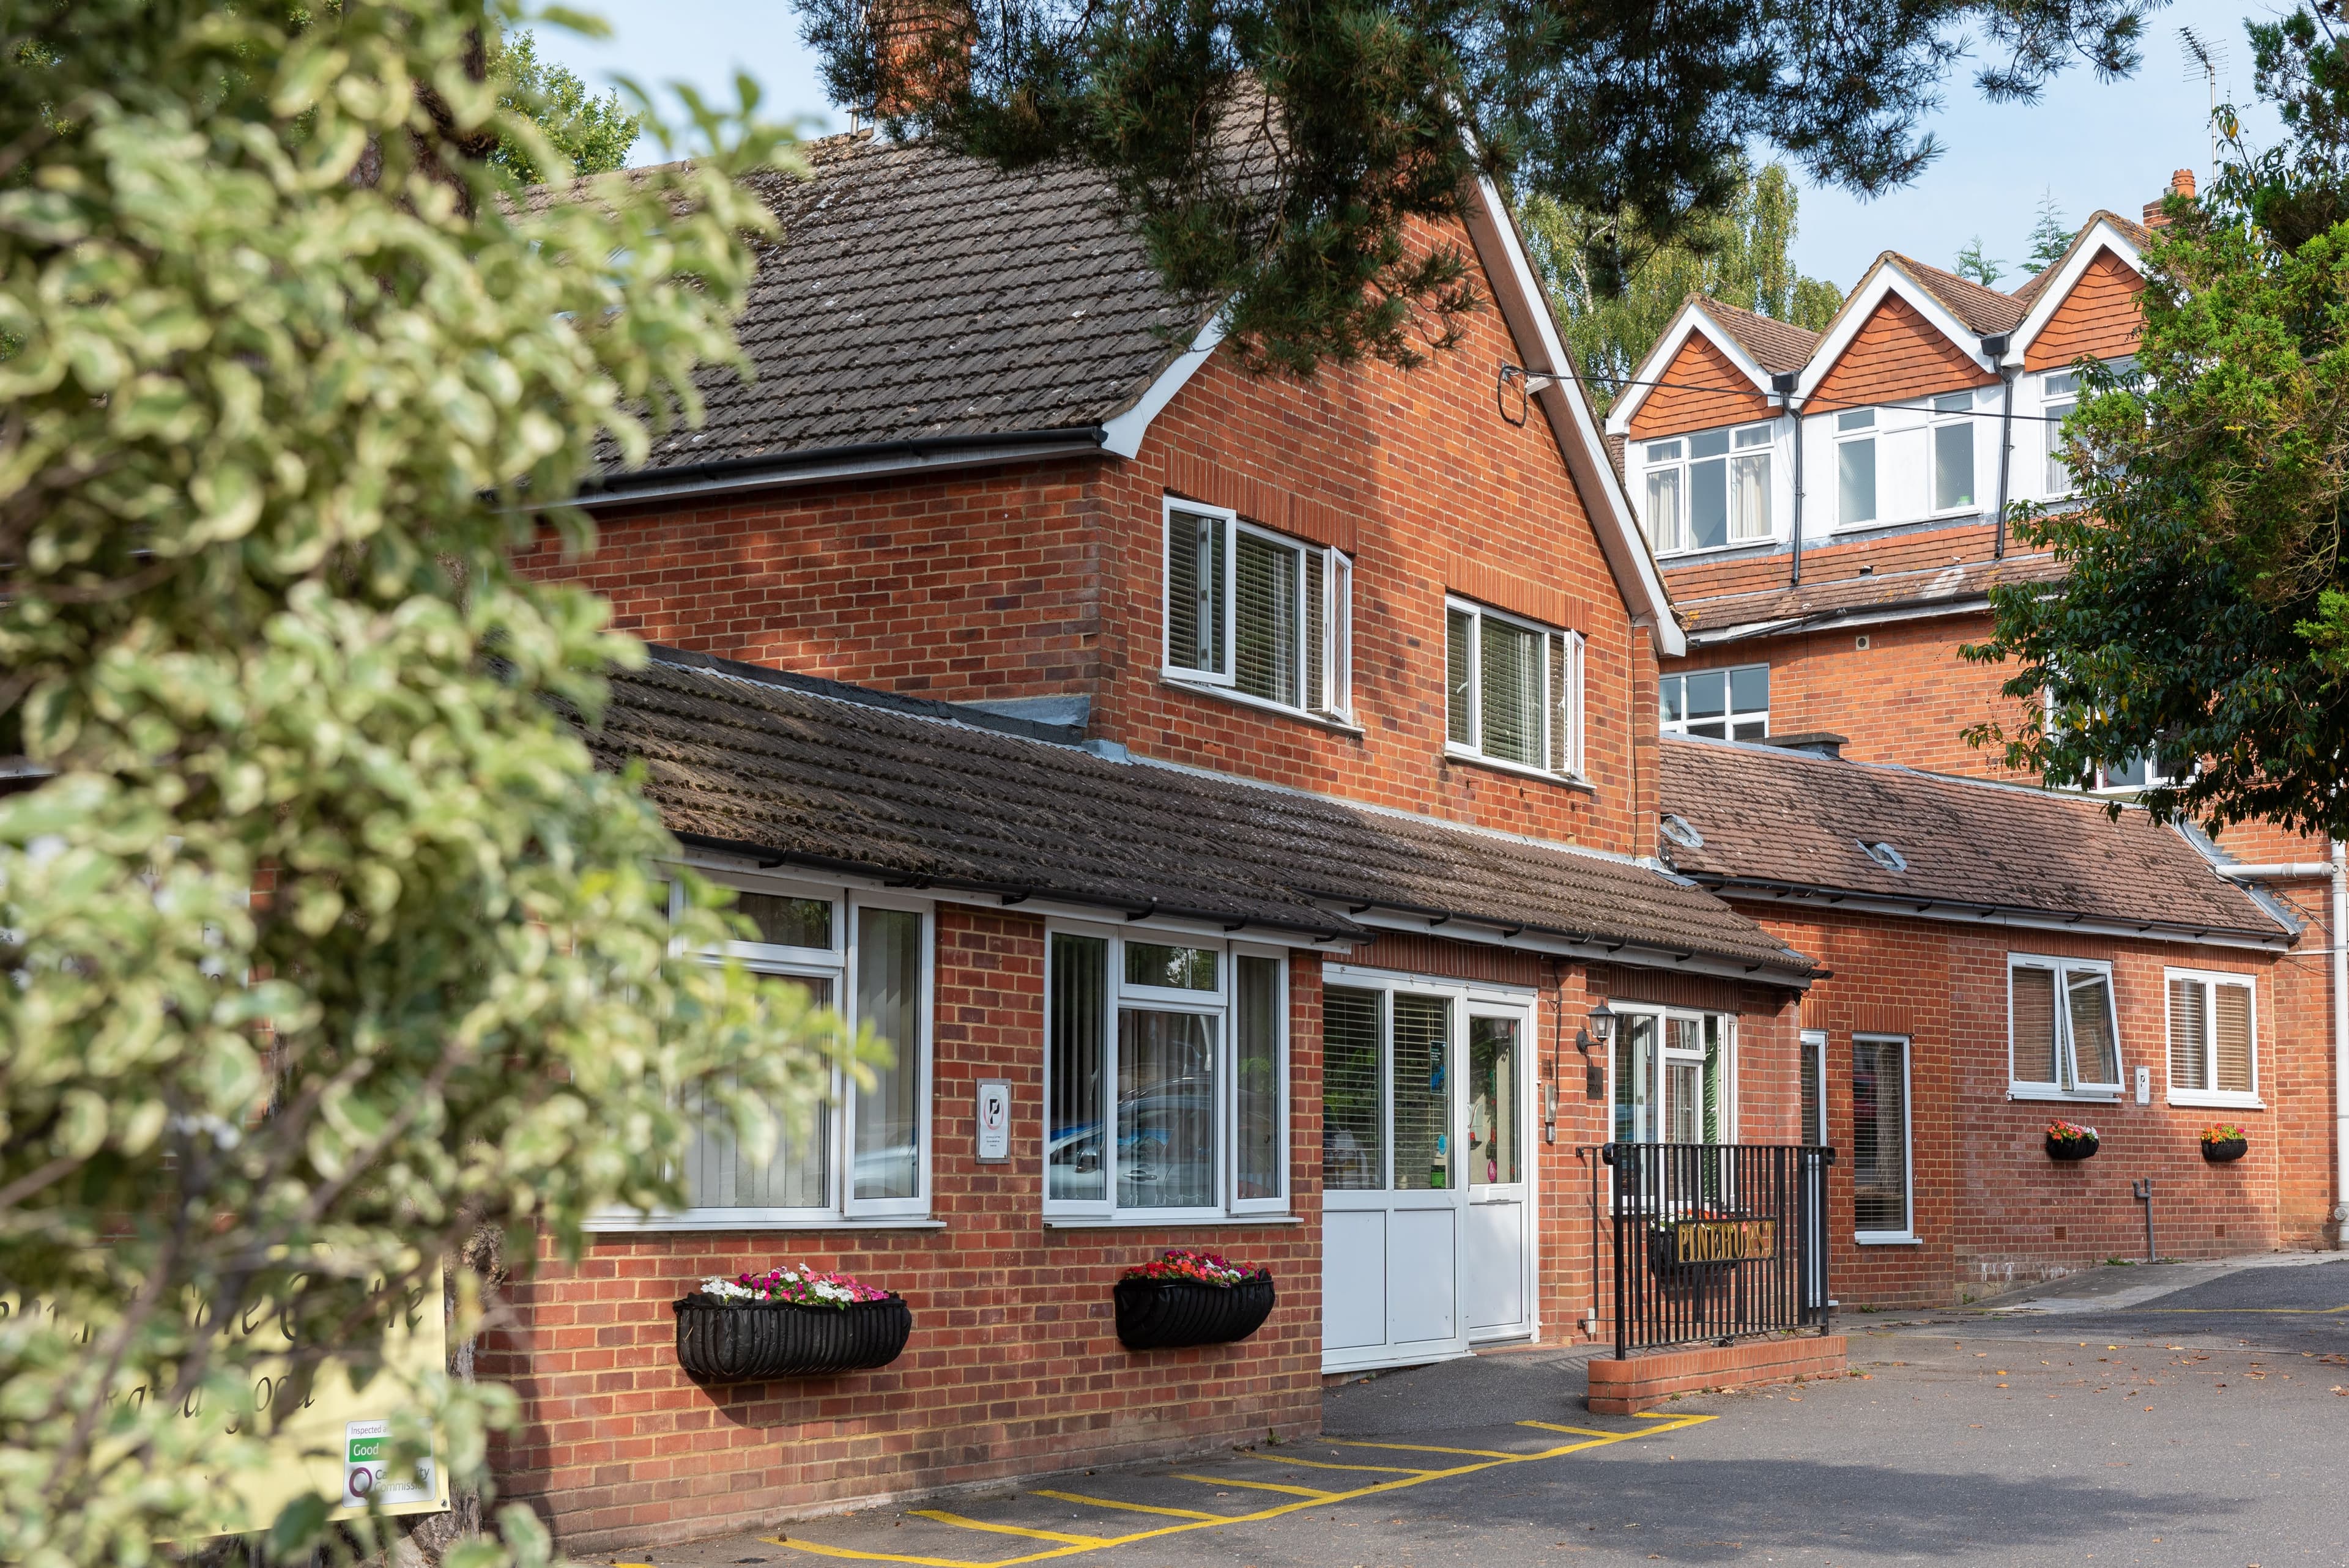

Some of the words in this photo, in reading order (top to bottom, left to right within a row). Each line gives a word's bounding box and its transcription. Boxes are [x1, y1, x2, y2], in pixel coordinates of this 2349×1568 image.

[1678, 1221, 1776, 1262] PINEHURST
[351, 1426, 382, 1436] Inspected
[354, 1443, 379, 1456] Good
[374, 1482, 424, 1492] Commissio
